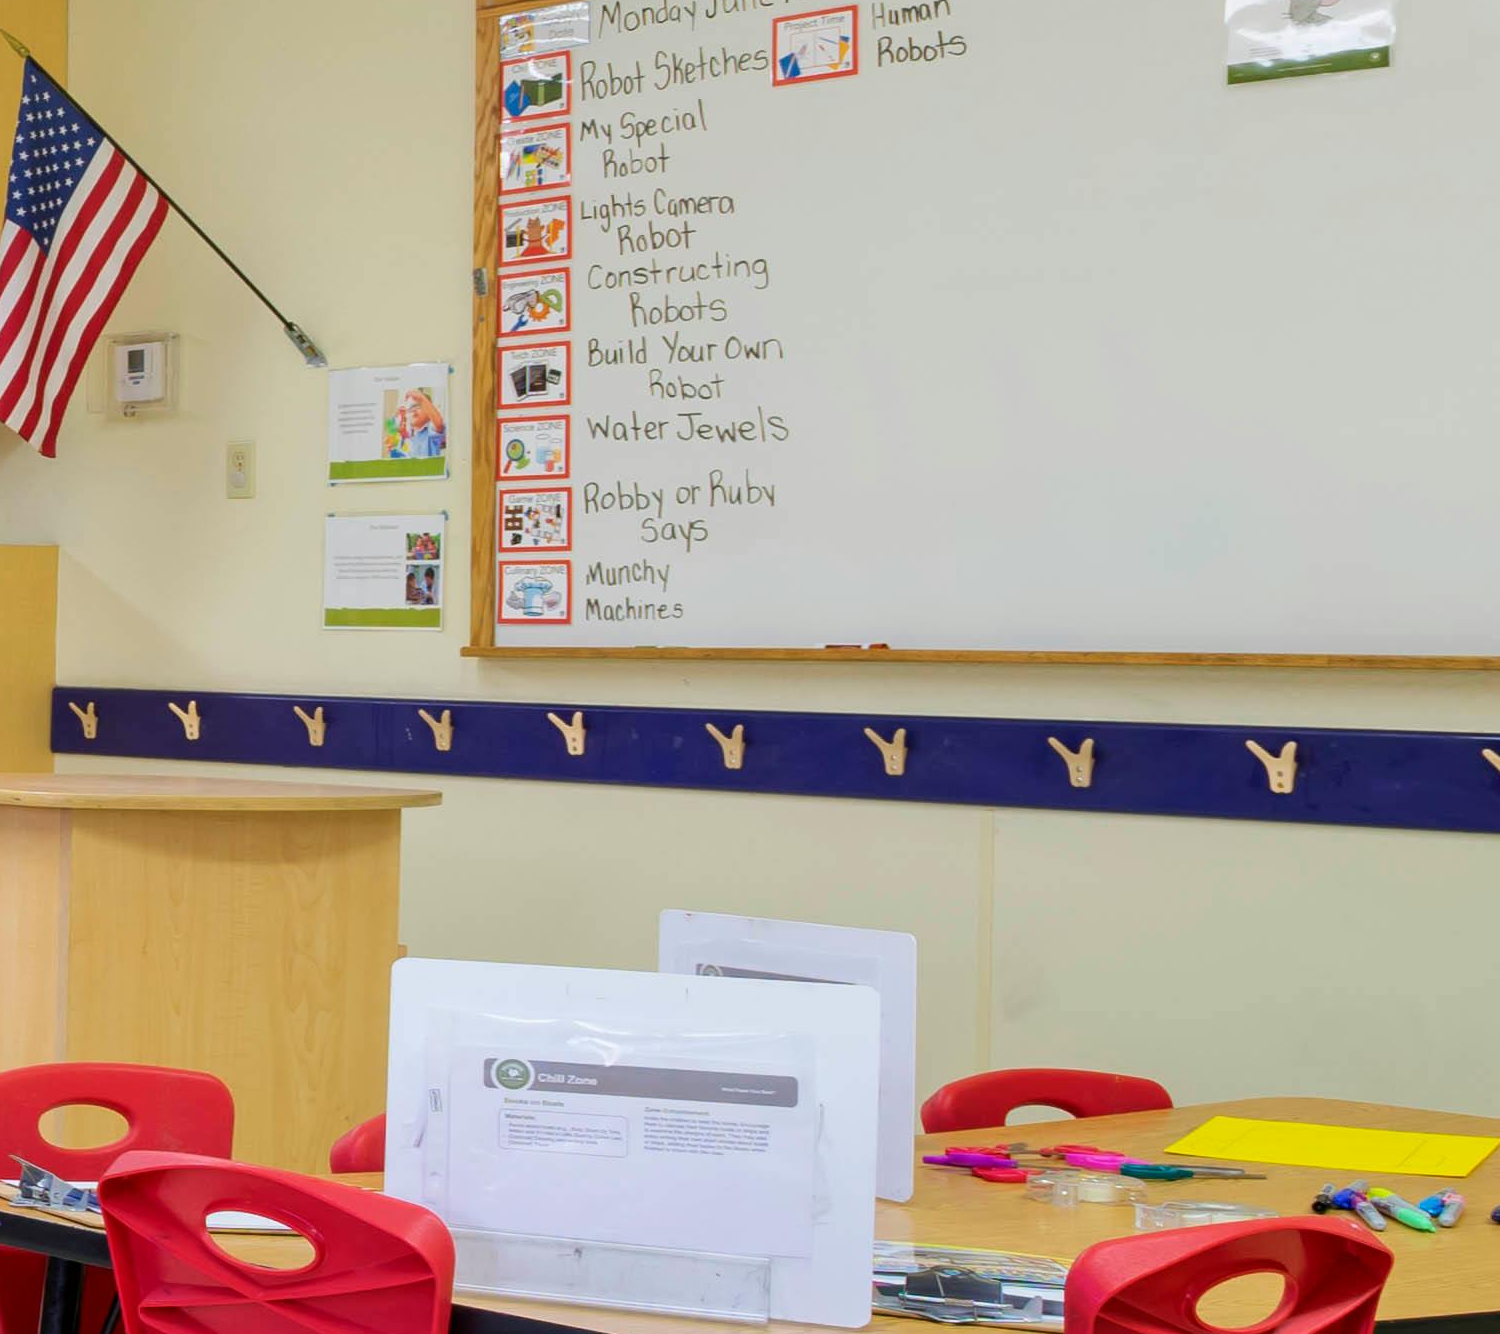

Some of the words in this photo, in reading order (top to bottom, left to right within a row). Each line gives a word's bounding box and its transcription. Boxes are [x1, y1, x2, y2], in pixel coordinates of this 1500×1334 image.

[877, 31, 967, 67] Robots
[579, 60, 644, 101] Robot
[654, 47, 769, 90] Sketches
[580, 120, 612, 144] My
[620, 99, 707, 147] Special
[602, 143, 670, 178] Robot
[581, 193, 645, 232] Lights
[654, 188, 735, 216] Camera
[617, 221, 696, 255] Robot
[587, 253, 769, 290] Constructing
[629, 291, 727, 327] Robots
[587, 332, 647, 367] Build
[662, 331, 717, 363] Your
[725, 336, 783, 361] Own
[649, 369, 725, 400] Robot
[587, 411, 669, 442] Water
[677, 406, 790, 443] Jewels
[583, 480, 663, 518] Robby
[676, 484, 700, 505] or
[709, 469, 776, 507] Ruby
[641, 518, 708, 552] Says
[585, 558, 670, 592] Munchy
[585, 597, 684, 622] Machines
[538, 1072, 565, 1084] Chill
[568, 1075, 597, 1085] Zone
